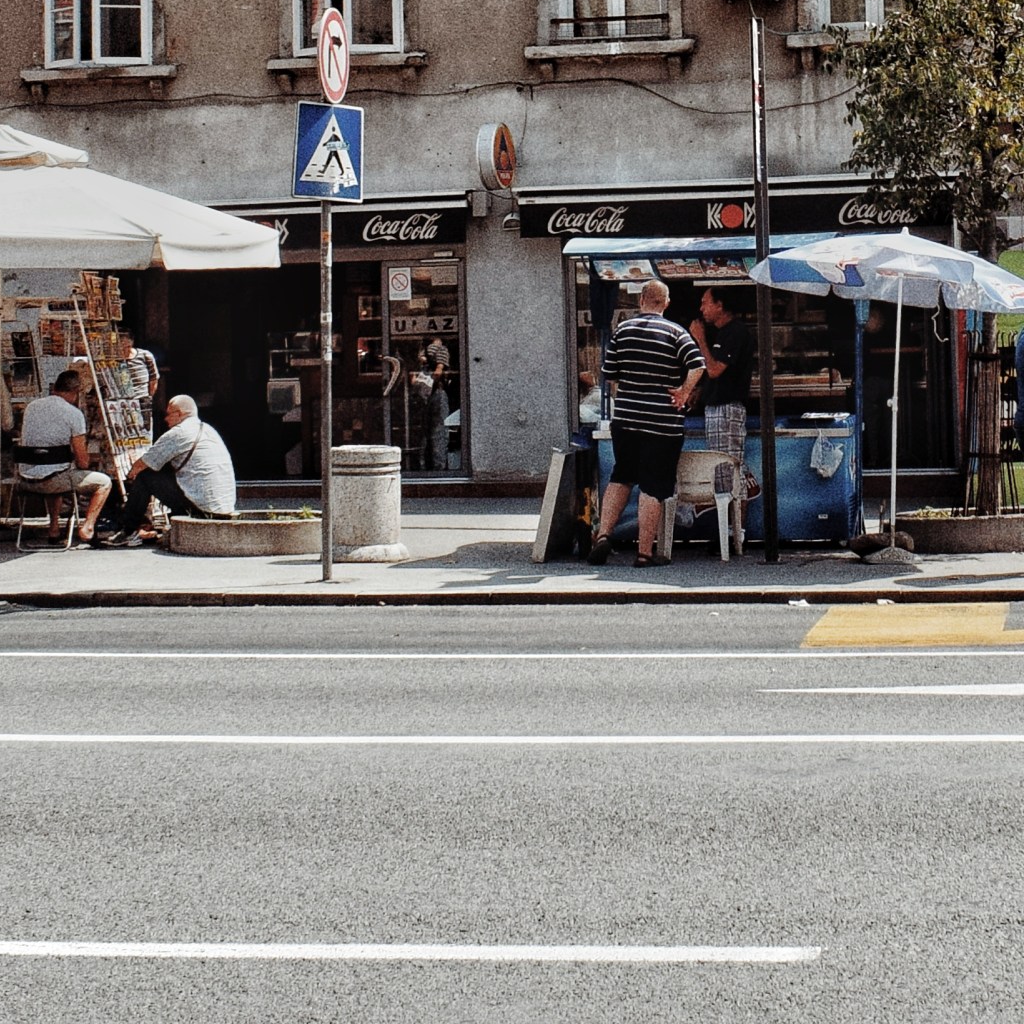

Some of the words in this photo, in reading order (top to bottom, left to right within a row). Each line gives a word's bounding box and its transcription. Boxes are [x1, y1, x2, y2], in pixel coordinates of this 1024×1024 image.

[362, 213, 442, 242] Coca-Cola
[547, 206, 629, 234] Coca-Cola
[394, 318, 454, 333] UAZ
